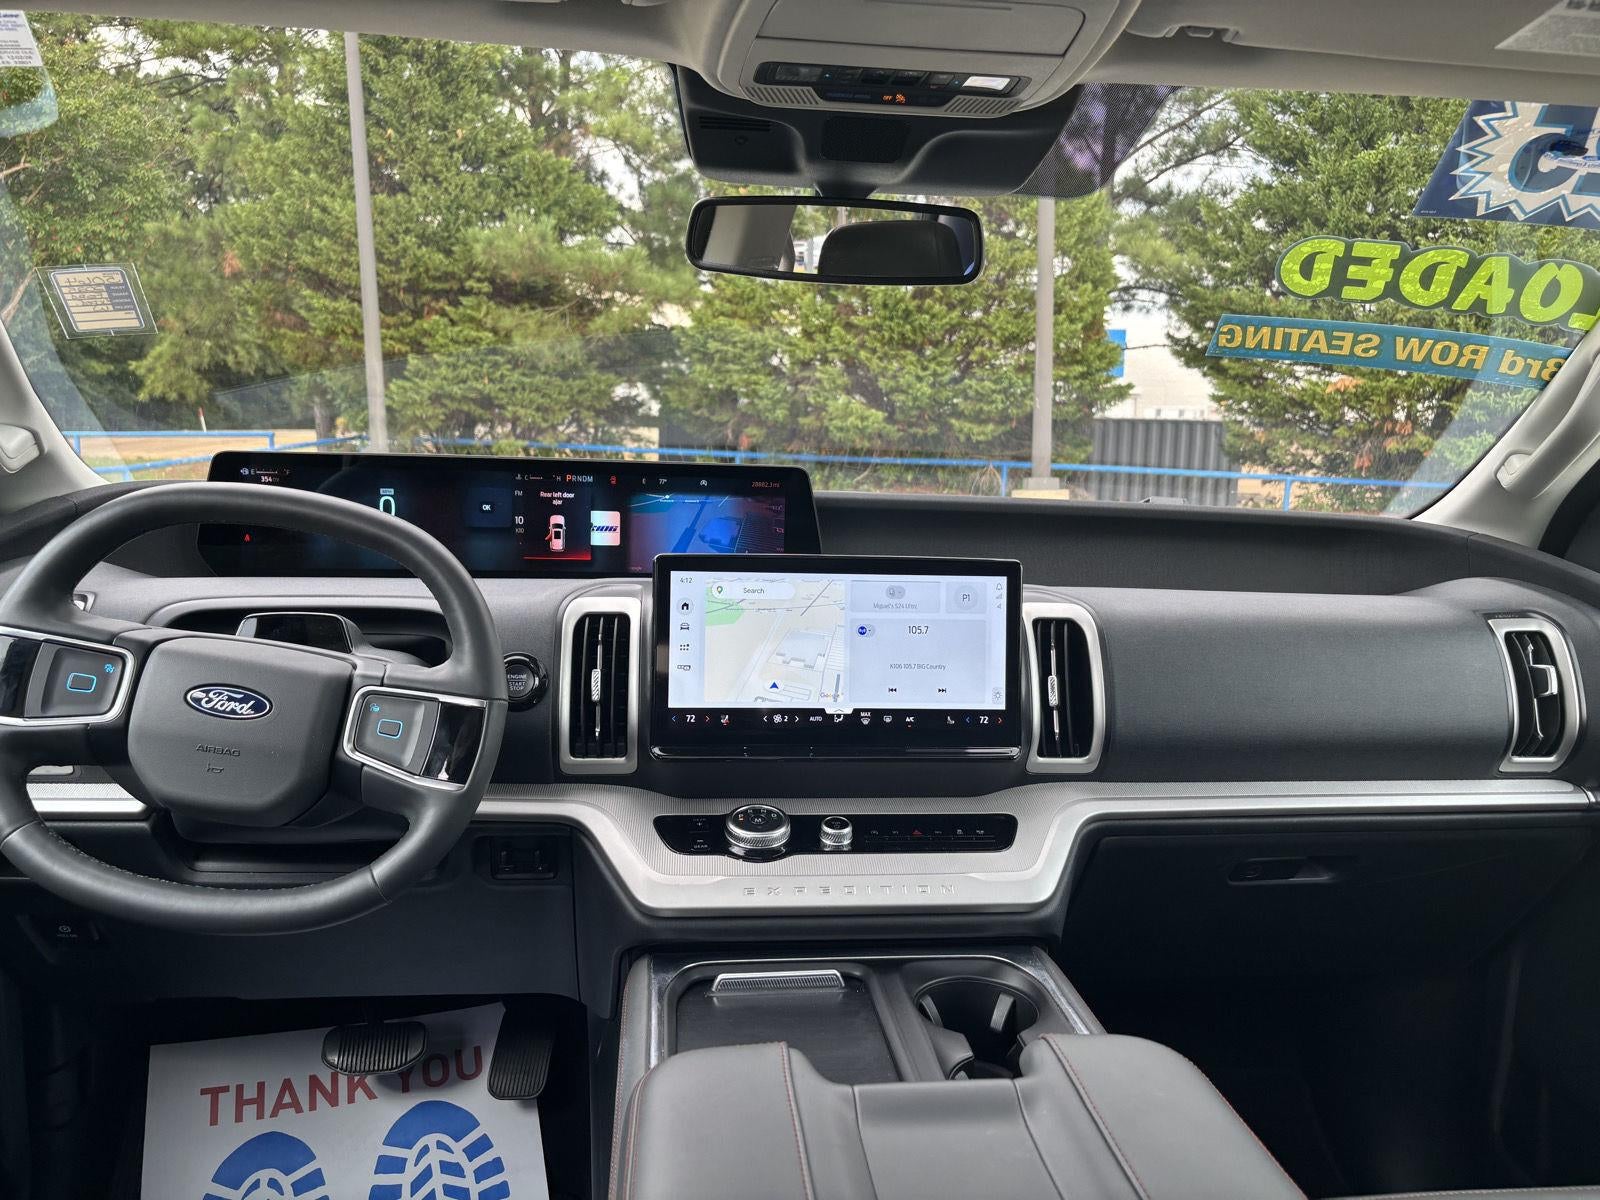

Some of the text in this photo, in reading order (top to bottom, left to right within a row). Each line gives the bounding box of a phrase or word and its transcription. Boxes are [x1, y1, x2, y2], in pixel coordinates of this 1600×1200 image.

[514, 516, 524, 524] 10
[962, 594, 971, 602] P1
[908, 625, 929, 634] 105.7
[198, 689, 256, 715] Ford
[686, 715, 696, 723] 72
[979, 716, 989, 724] 72
[195, 743, 241, 757] AIRBAG
[743, 885, 955, 895] EXPEDITION
[200, 1072, 378, 1126] THANK
